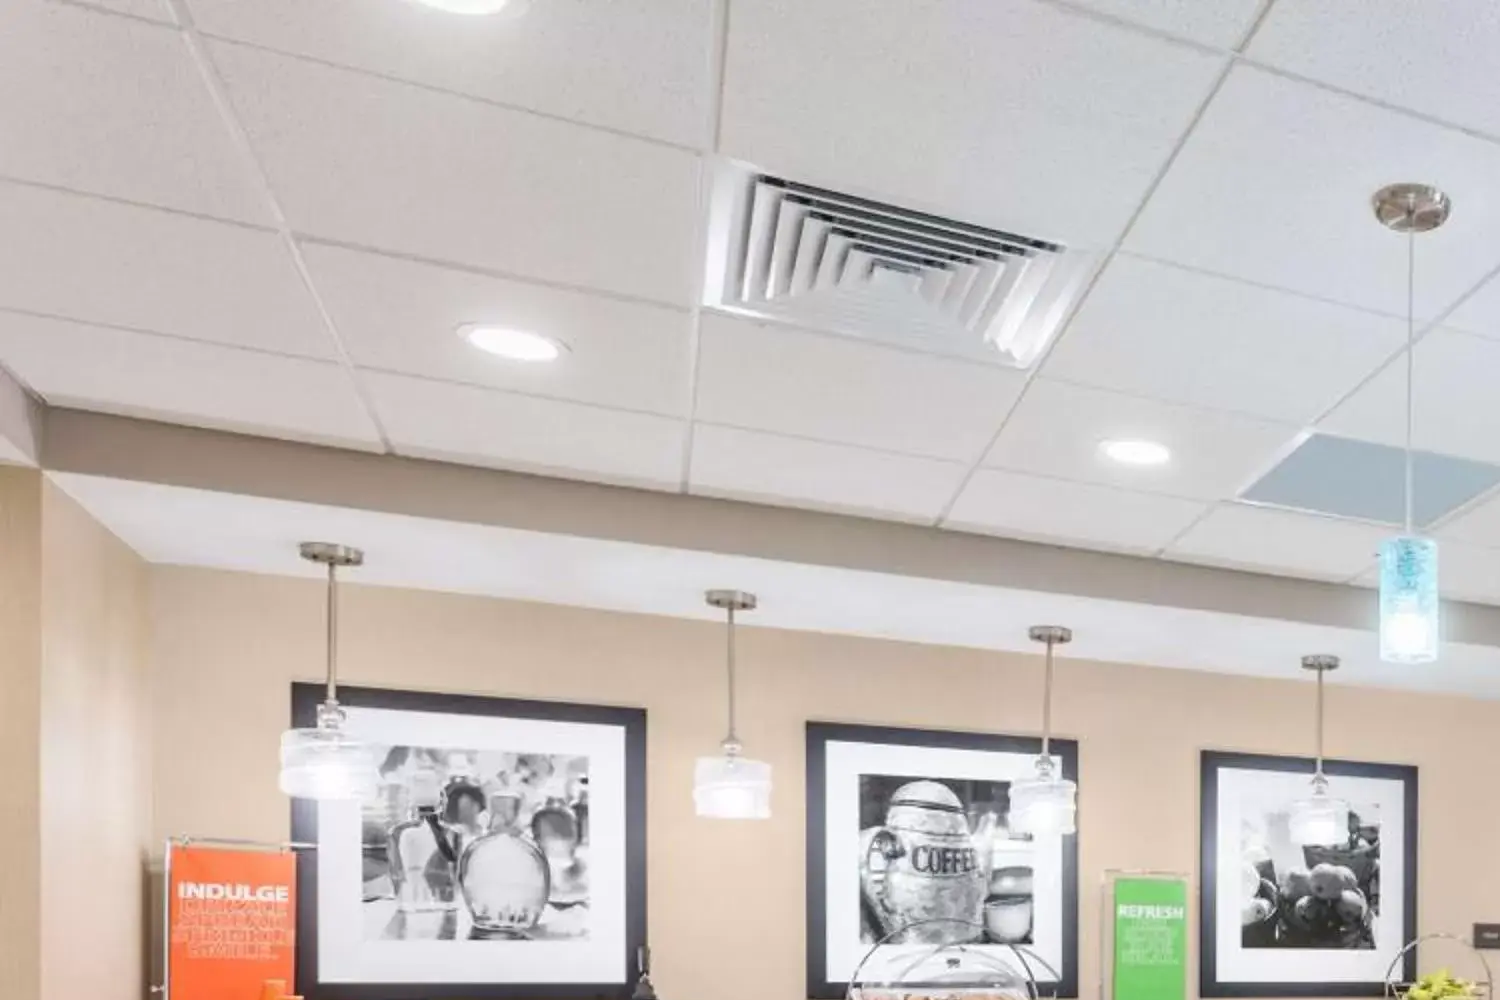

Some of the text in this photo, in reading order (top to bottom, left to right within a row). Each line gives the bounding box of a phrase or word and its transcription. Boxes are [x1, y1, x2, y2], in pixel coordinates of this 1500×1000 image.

[911, 845, 977, 874] COFFEE
[177, 881, 289, 902] INDULGE
[1118, 904, 1184, 920] REFRESH
